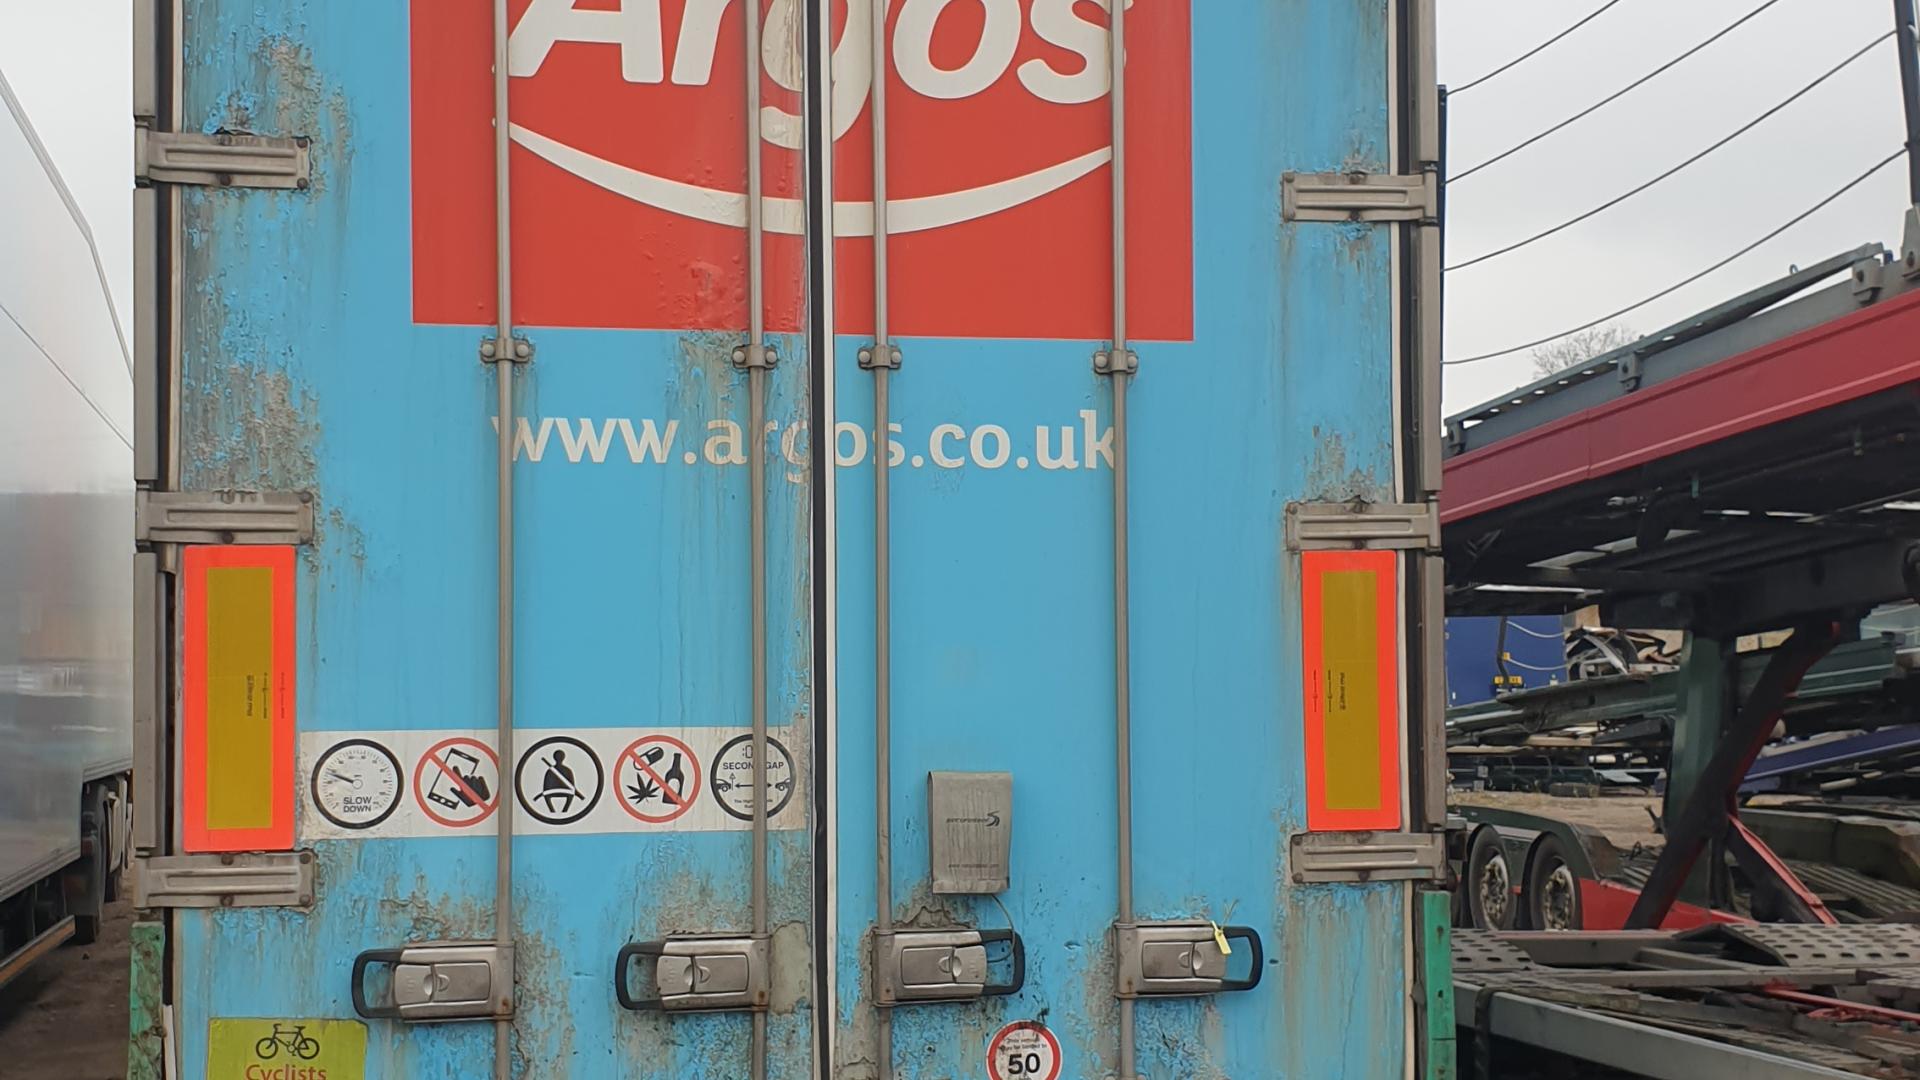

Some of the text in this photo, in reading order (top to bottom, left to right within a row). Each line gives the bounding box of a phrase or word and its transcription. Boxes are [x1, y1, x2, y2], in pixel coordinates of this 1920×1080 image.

[492, 0, 1133, 150] Argos
[343, 796, 372, 805] SLOW
[343, 805, 372, 813] DOWN
[1008, 1053, 1040, 1074] 50
[245, 1064, 327, 1080] Cyclists
